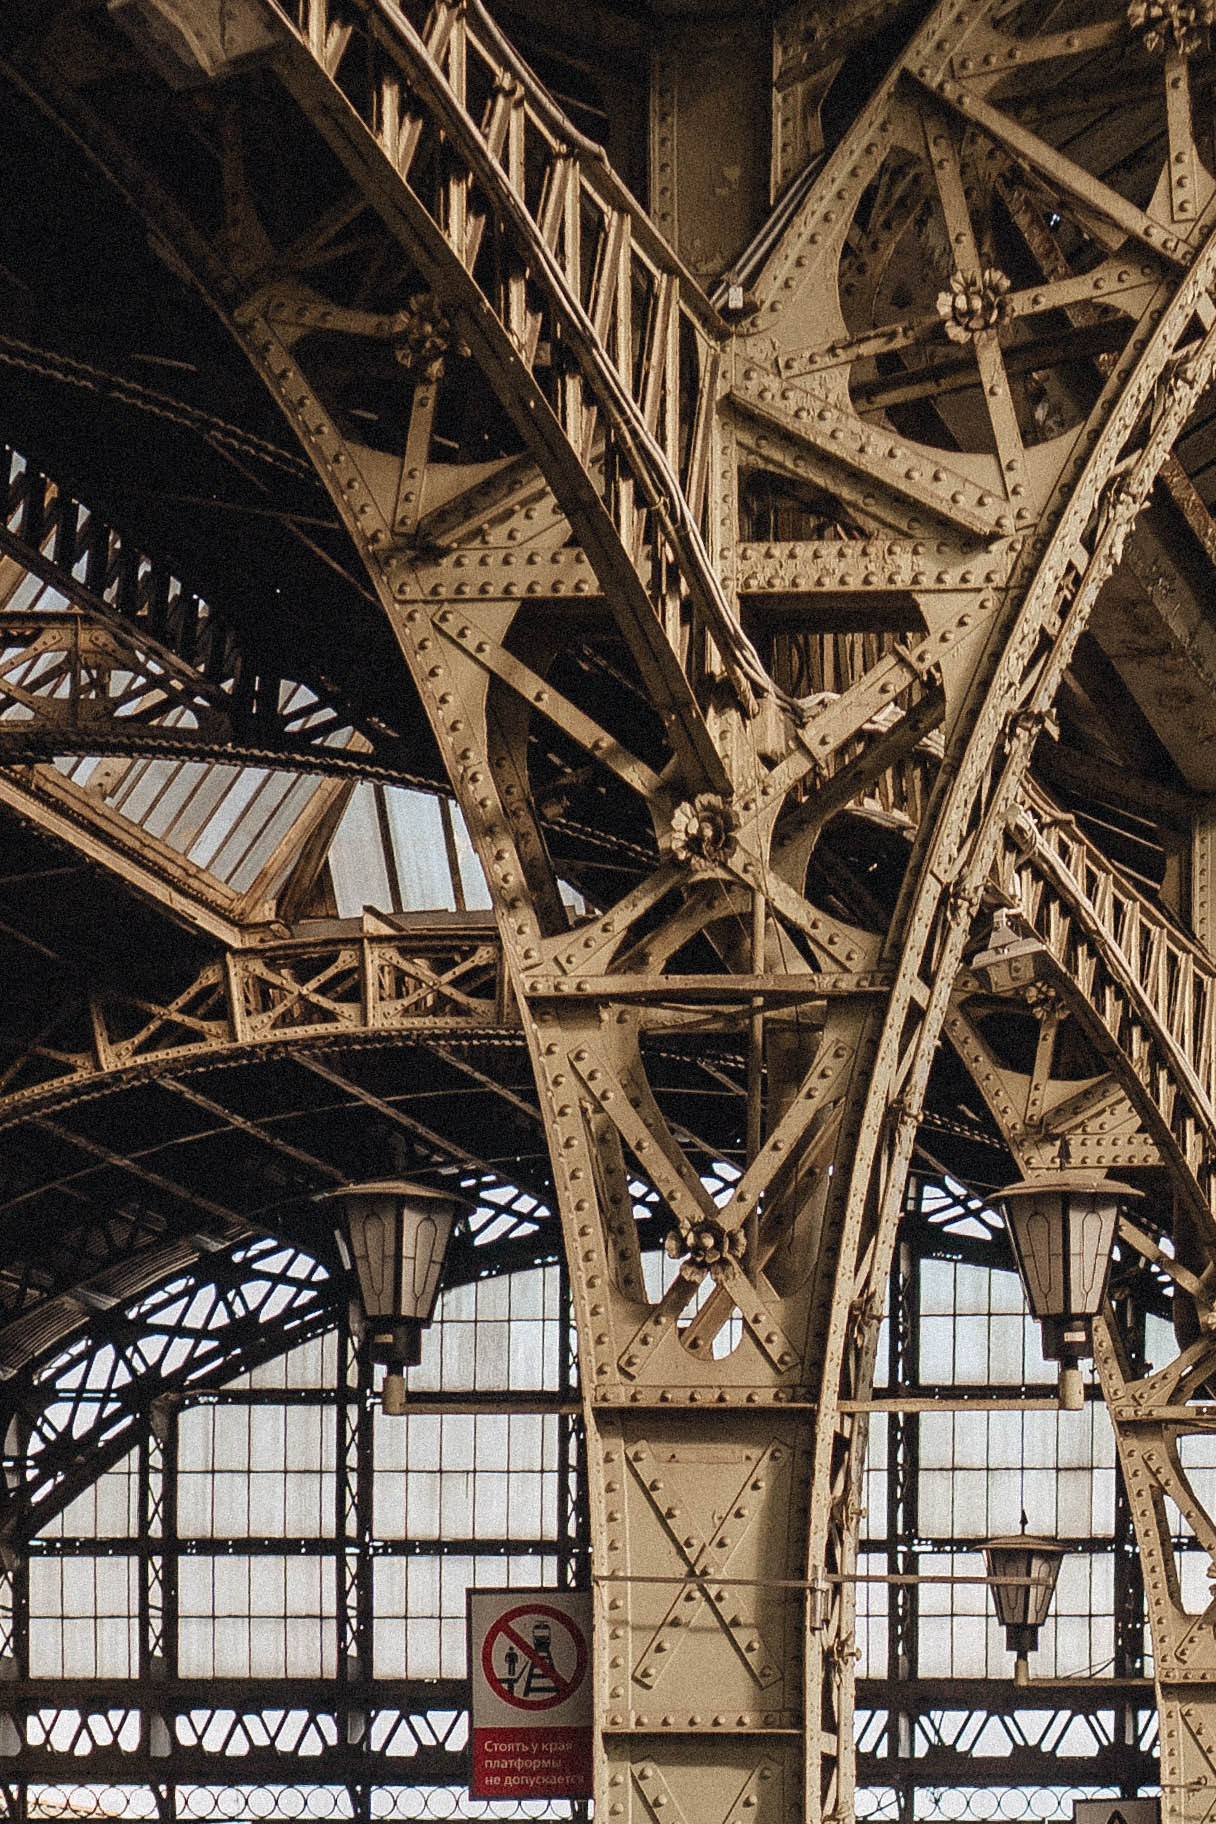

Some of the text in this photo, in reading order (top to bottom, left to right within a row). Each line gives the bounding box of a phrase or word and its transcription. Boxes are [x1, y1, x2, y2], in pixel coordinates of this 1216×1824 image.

[484, 1740, 574, 1754] Стоять у края
[484, 1758, 562, 1771] платформы
[485, 1775, 585, 1787] не допускается
